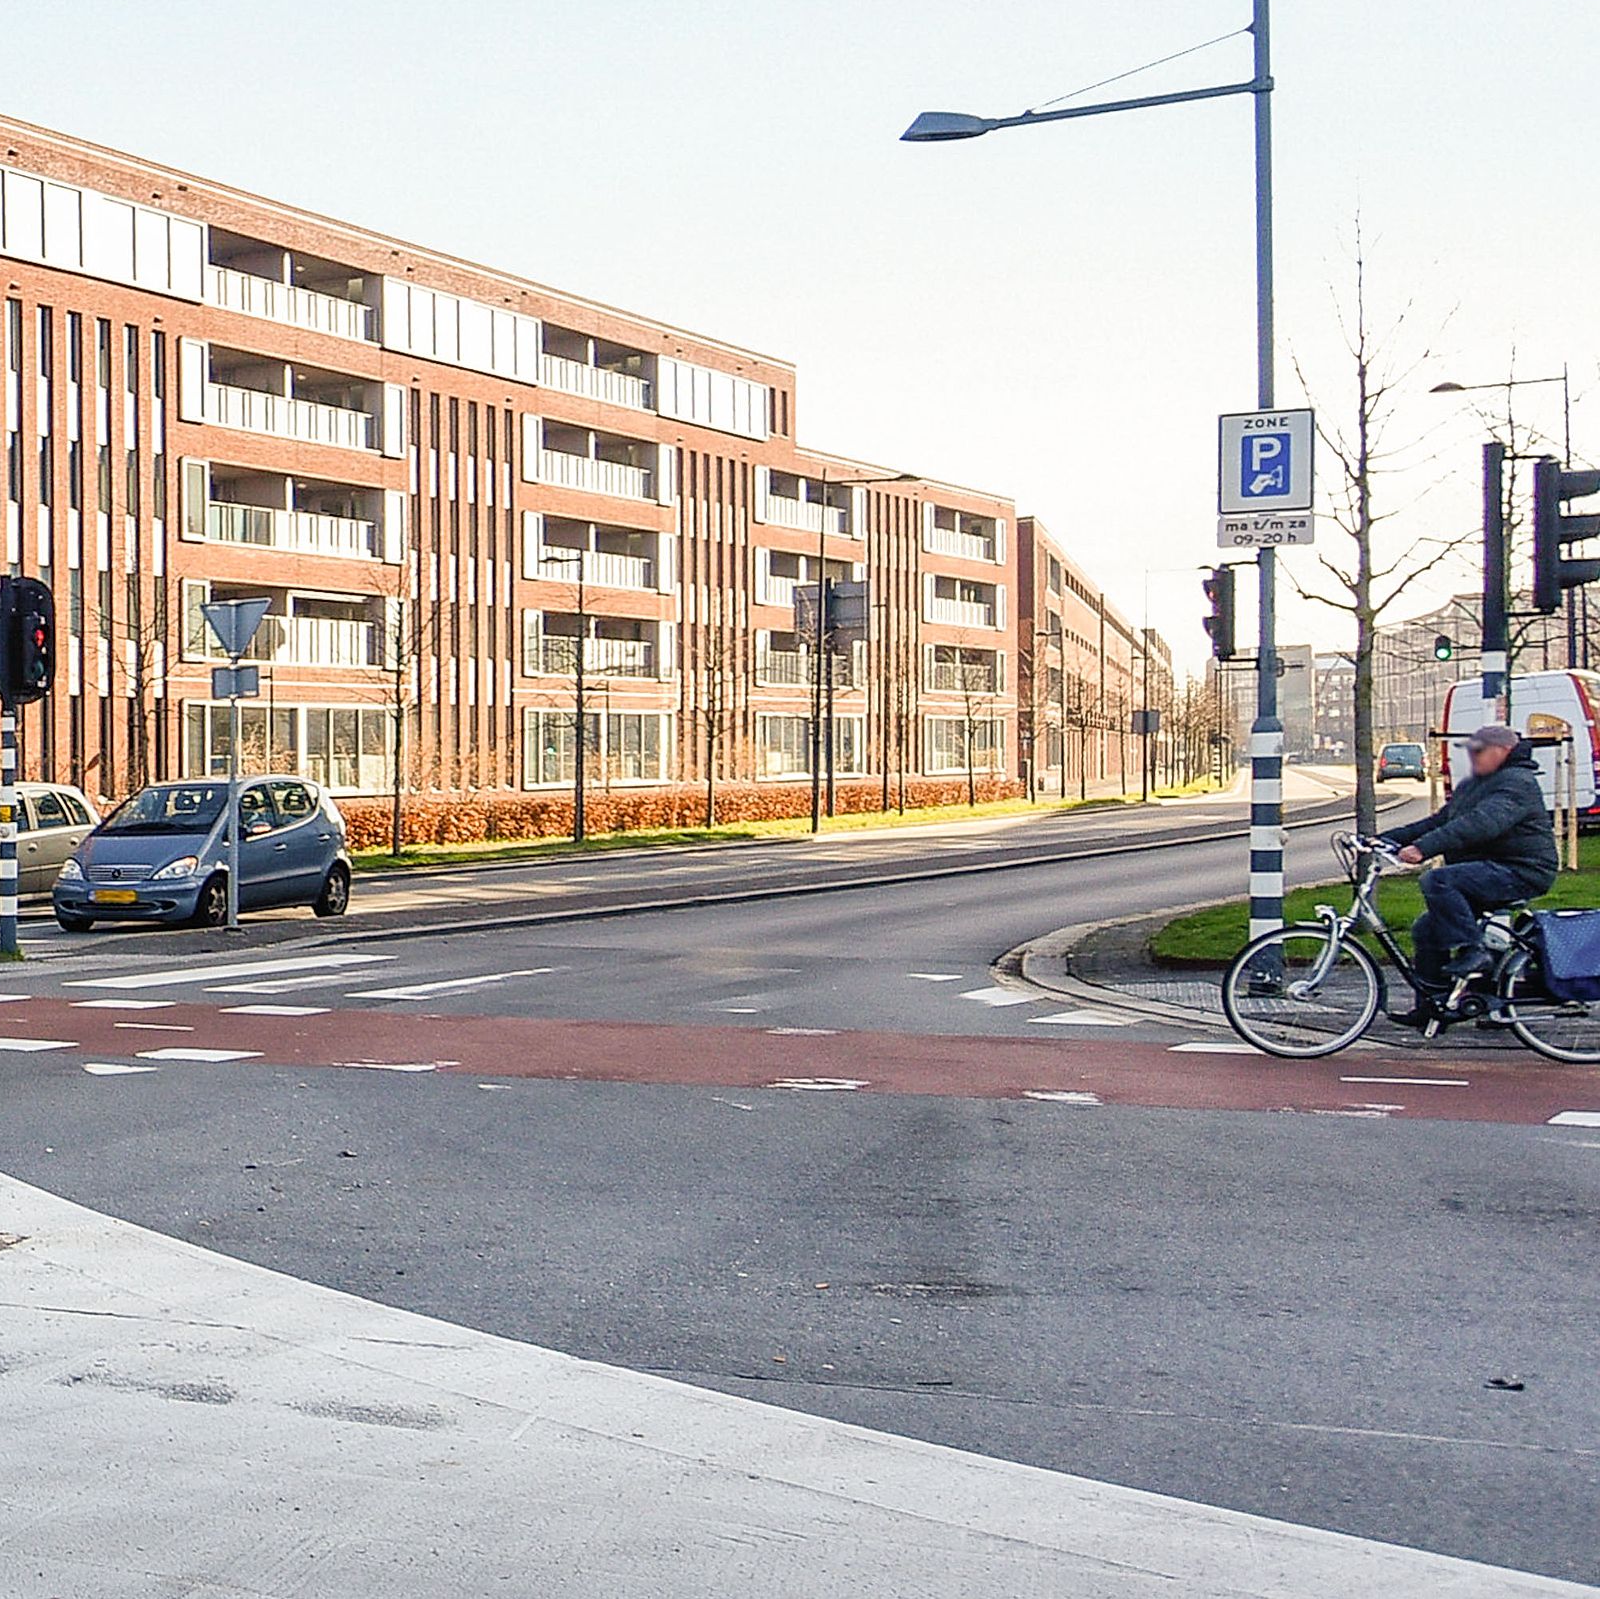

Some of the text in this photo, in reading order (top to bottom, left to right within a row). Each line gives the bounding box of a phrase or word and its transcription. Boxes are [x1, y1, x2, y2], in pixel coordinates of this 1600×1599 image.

[1243, 416, 1289, 429] ZONE
[1225, 519, 1307, 532] ma t/m za
[1233, 532, 1297, 545] 09-20 h
